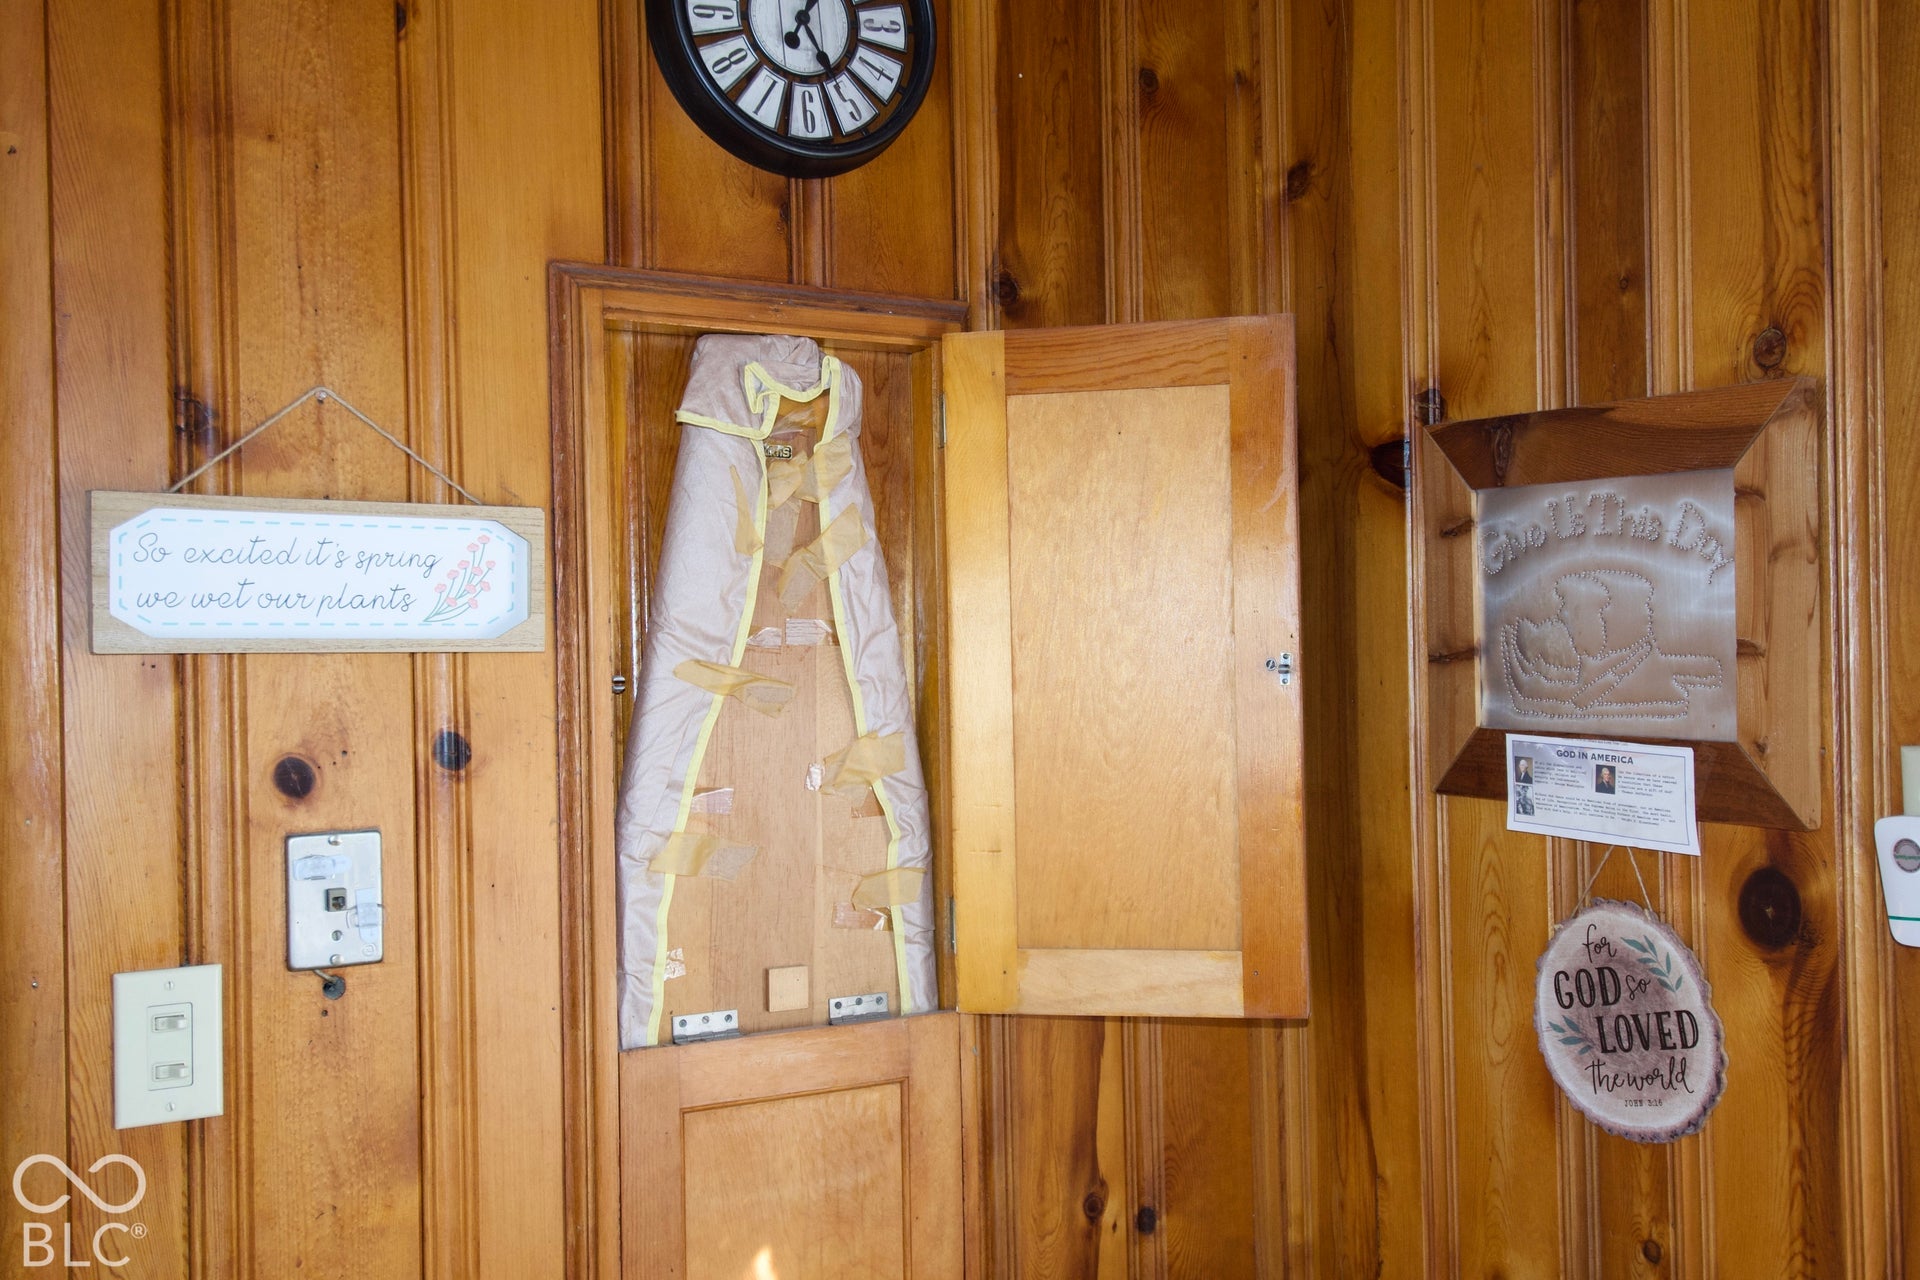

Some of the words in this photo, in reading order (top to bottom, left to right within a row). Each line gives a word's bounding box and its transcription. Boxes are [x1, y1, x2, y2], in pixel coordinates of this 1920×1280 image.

[863, 17, 901, 33] 3
[712, 47, 748, 74] 8
[858, 56, 894, 83] 4
[752, 74, 779, 116] 7
[801, 89, 816, 134] 6
[833, 80, 862, 122] 5
[133, 532, 172, 563] So
[183, 535, 300, 565] excited
[305, 537, 351, 569] it's
[355, 549, 442, 579] spring
[1480, 524, 1548, 575] Give
[1546, 496, 1586, 540] Us
[1587, 493, 1662, 542] This
[1668, 502, 1735, 586] Day
[136, 591, 186, 609] we
[191, 578, 255, 609] wet
[257, 592, 315, 610] our
[316, 582, 417, 618] plants
[1556, 749, 1576, 759] GOD
[1578, 752, 1588, 760] IN
[1591, 753, 1634, 765] AMERICA
[1582, 923, 1617, 963] for
[1553, 966, 1622, 1009] GOD
[1625, 974, 1652, 1001] so
[1595, 1010, 1699, 1054] LOVED
[1585, 1058, 1624, 1095] the
[1626, 1055, 1694, 1094] world
[1624, 1099, 1643, 1107] JOHN
[1648, 1098, 1663, 1107] 3:16
